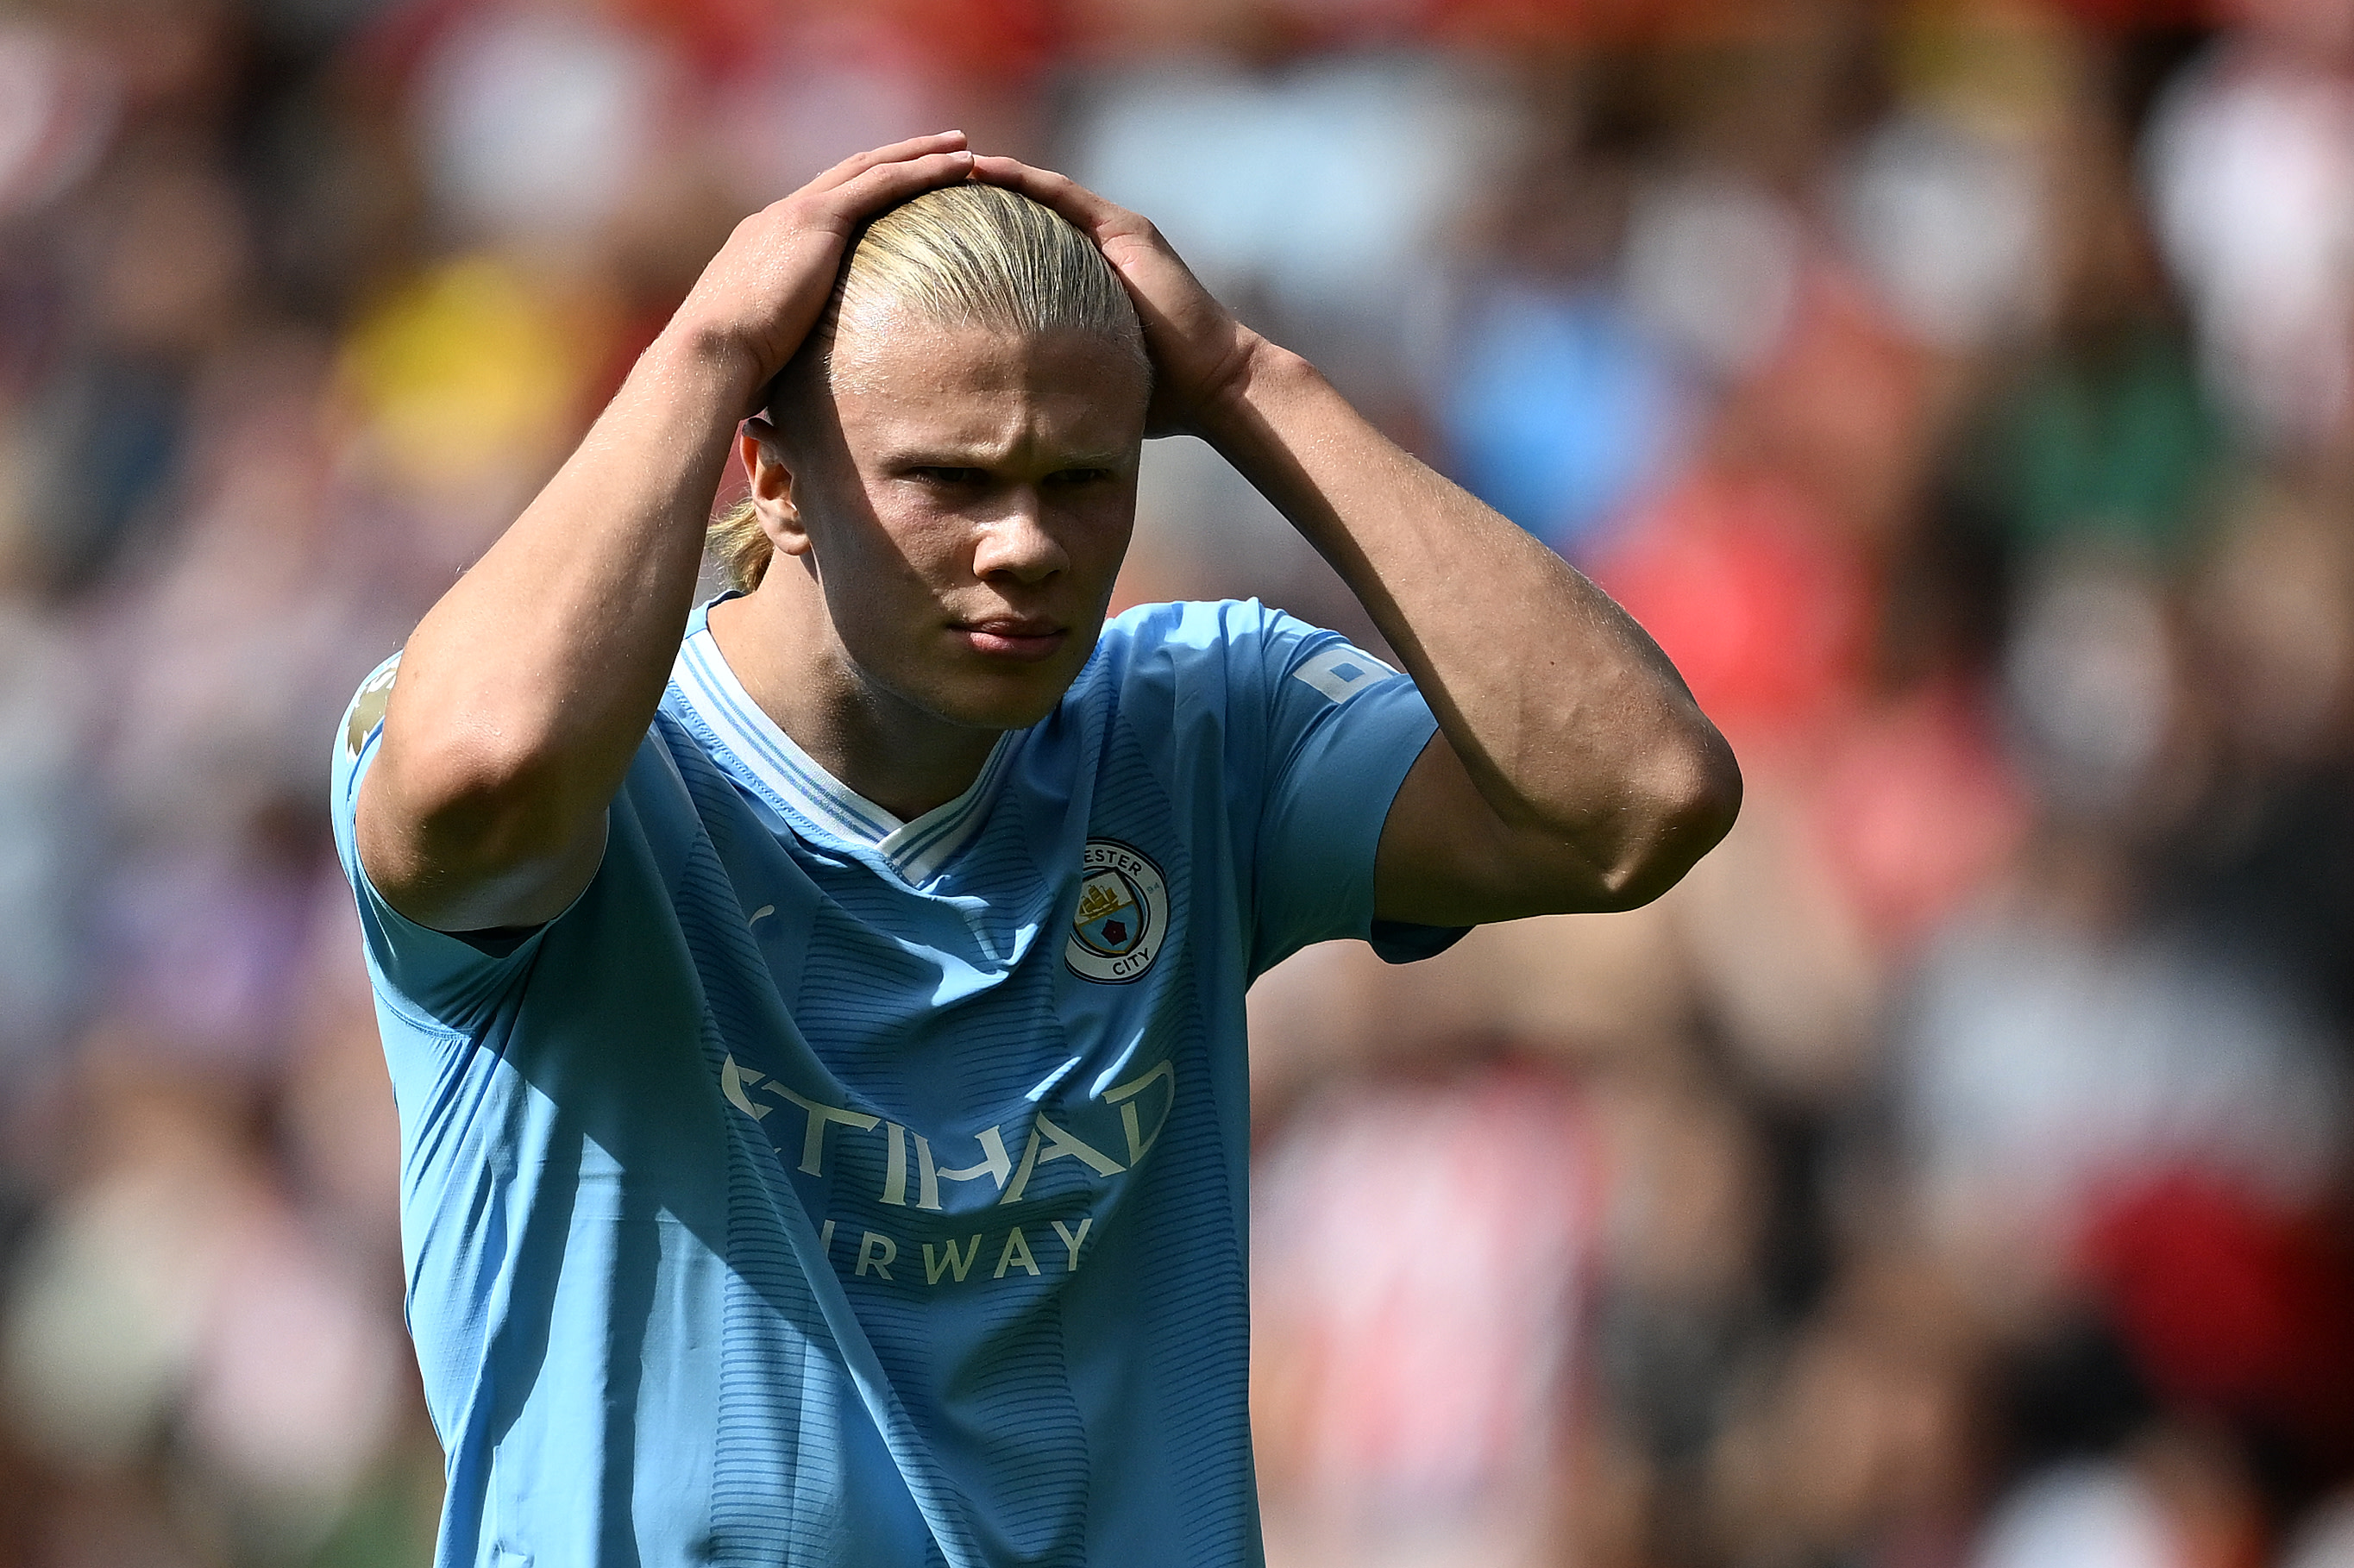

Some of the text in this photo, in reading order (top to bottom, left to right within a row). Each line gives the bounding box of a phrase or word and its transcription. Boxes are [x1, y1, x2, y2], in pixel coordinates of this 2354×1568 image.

[1083, 849, 1142, 877] ESTER
[1112, 947, 1150, 975] CITY
[721, 1052, 1175, 1210] ETIHAD
[819, 1218, 1094, 1285] IRWAY
